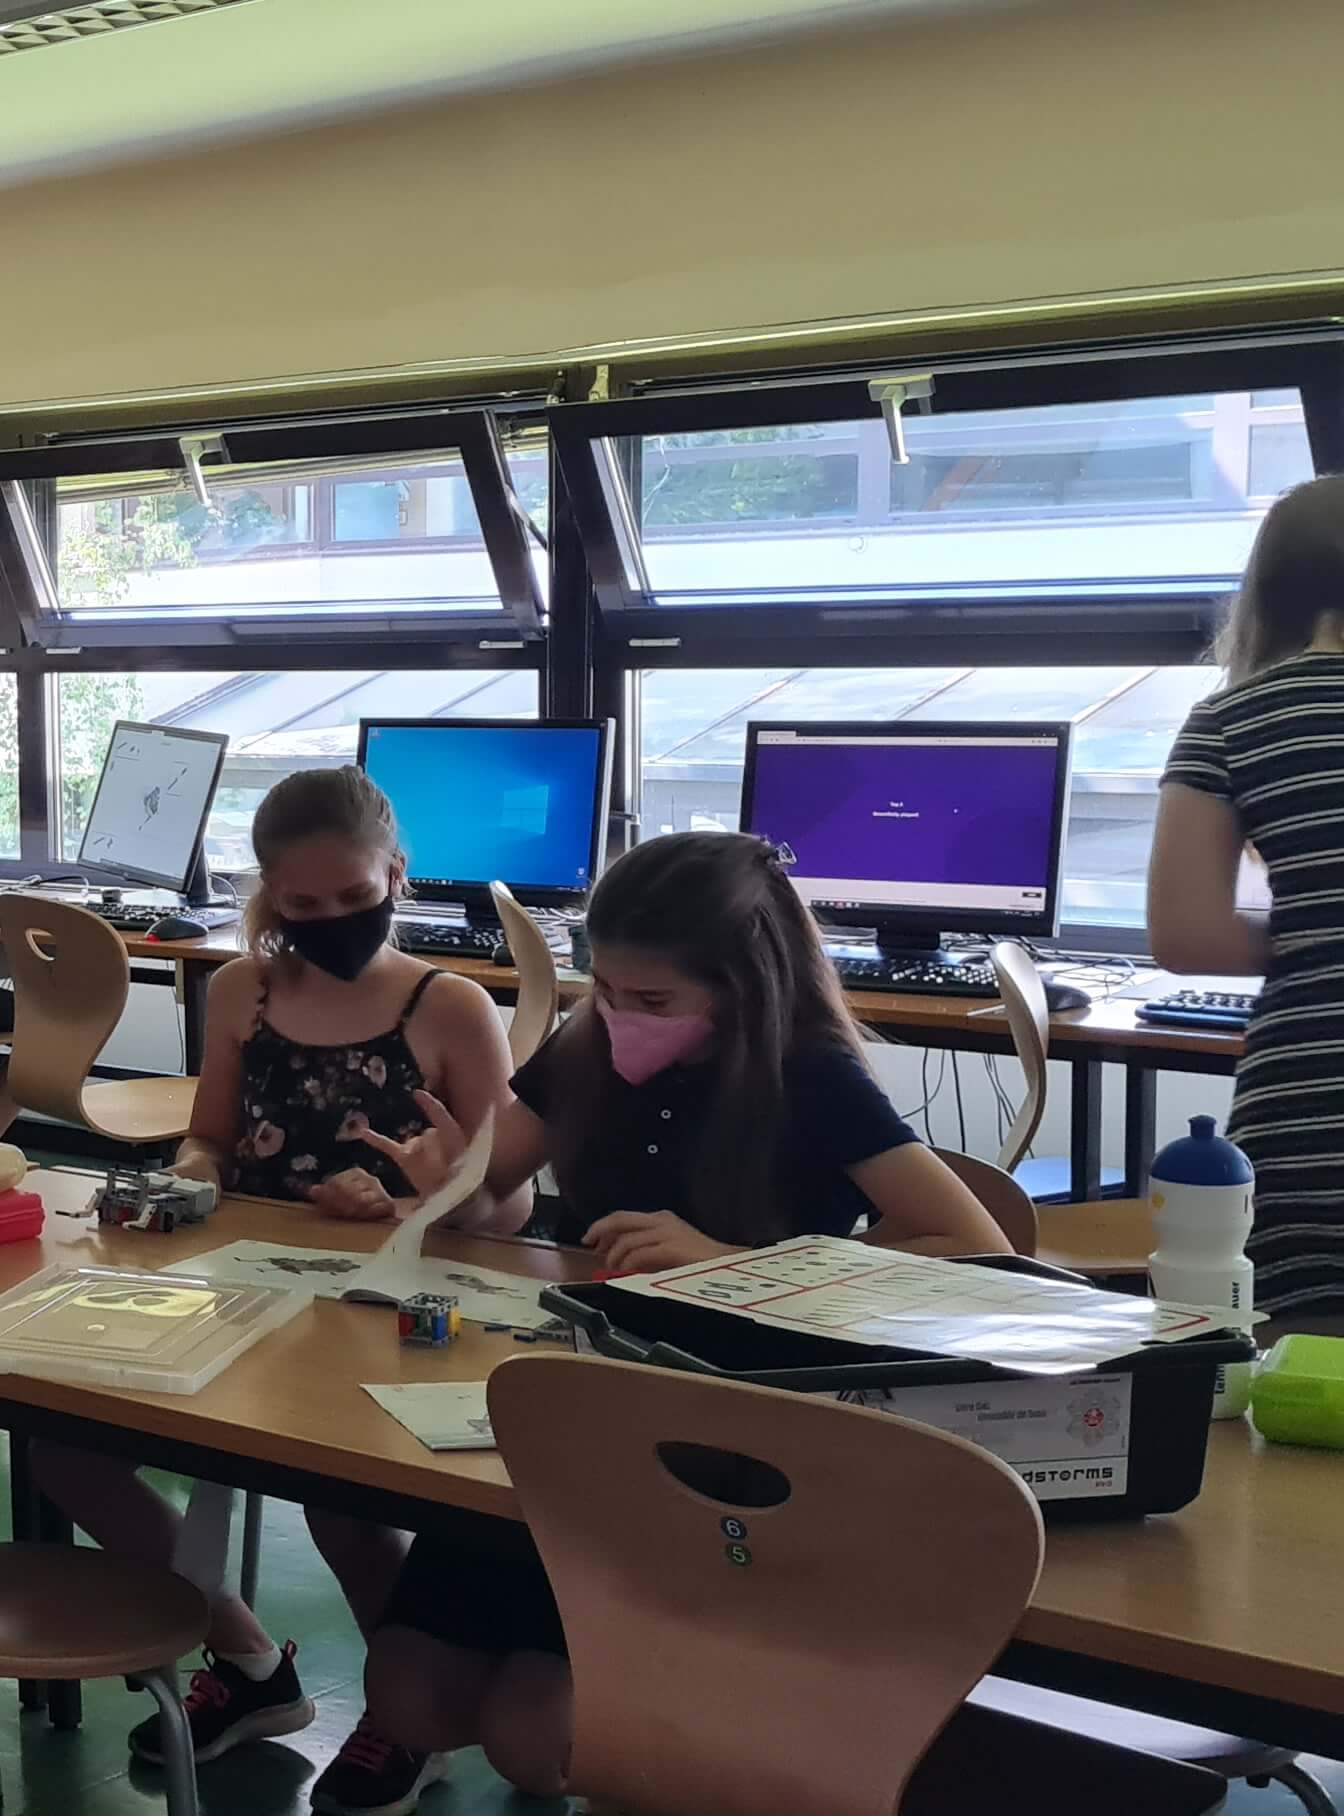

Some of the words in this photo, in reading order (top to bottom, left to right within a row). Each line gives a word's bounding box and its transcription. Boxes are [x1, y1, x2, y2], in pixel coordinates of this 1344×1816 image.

[1232, 1281, 1240, 1309] auer
[1215, 1363, 1225, 1394] tenn
[1022, 1467, 1113, 1483] dstorms
[726, 1519, 741, 1537] 6
[732, 1546, 746, 1562] 5
